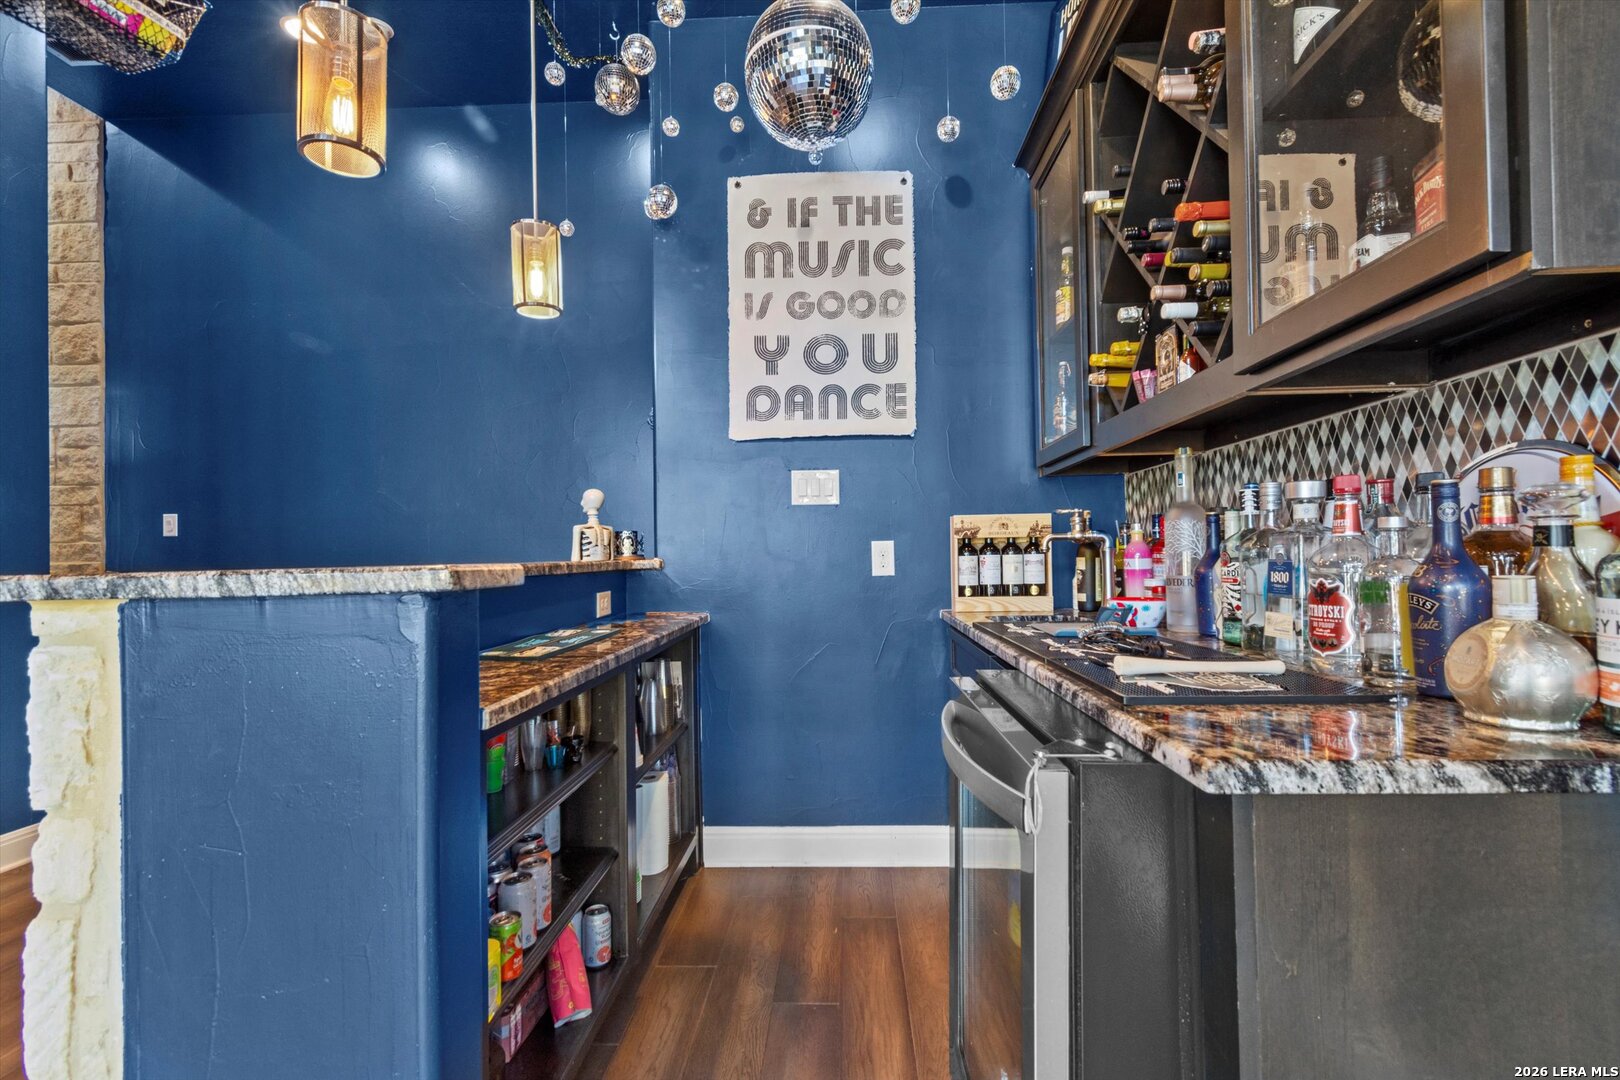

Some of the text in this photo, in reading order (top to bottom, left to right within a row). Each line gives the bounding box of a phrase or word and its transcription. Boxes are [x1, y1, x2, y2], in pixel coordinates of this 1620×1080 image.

[746, 195, 904, 230] & IF THE
[744, 238, 906, 280] MUSIC
[744, 288, 907, 321] IS GOOD
[753, 332, 899, 376] YOU
[746, 382, 907, 422] DANCE
[1269, 571, 1290, 584] 1800
